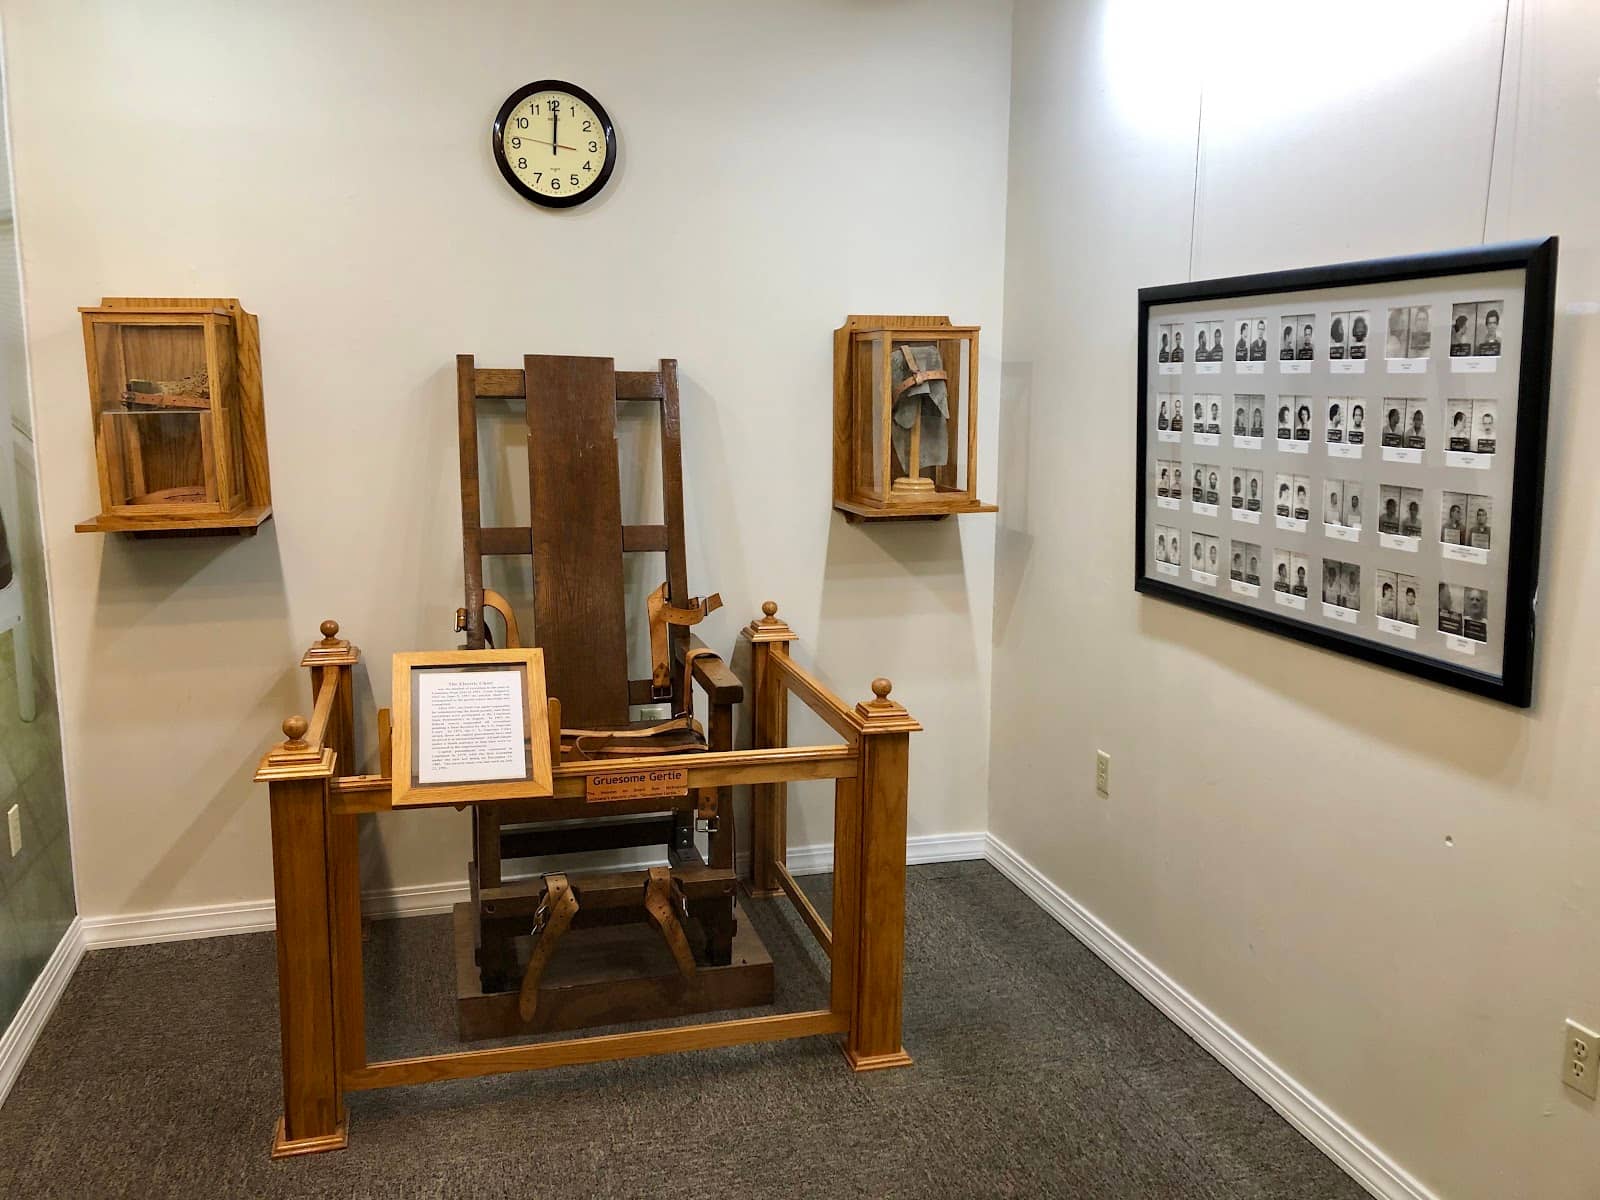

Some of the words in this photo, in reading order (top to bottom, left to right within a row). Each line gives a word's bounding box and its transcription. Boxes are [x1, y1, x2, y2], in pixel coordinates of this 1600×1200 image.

[530, 104, 540, 116] 11
[547, 100, 560, 112] 12
[570, 107, 575, 117] 1
[516, 117, 529, 129] 10
[582, 120, 591, 133] 2
[511, 137, 521, 149] 9
[588, 141, 598, 153] 3
[518, 157, 527, 169] 8
[582, 160, 592, 172] 4
[533, 172, 543, 184] 7
[551, 178, 561, 190] 6
[570, 174, 579, 186] 5
[593, 774, 646, 786] Gruesome
[649, 771, 682, 781] Gertie
